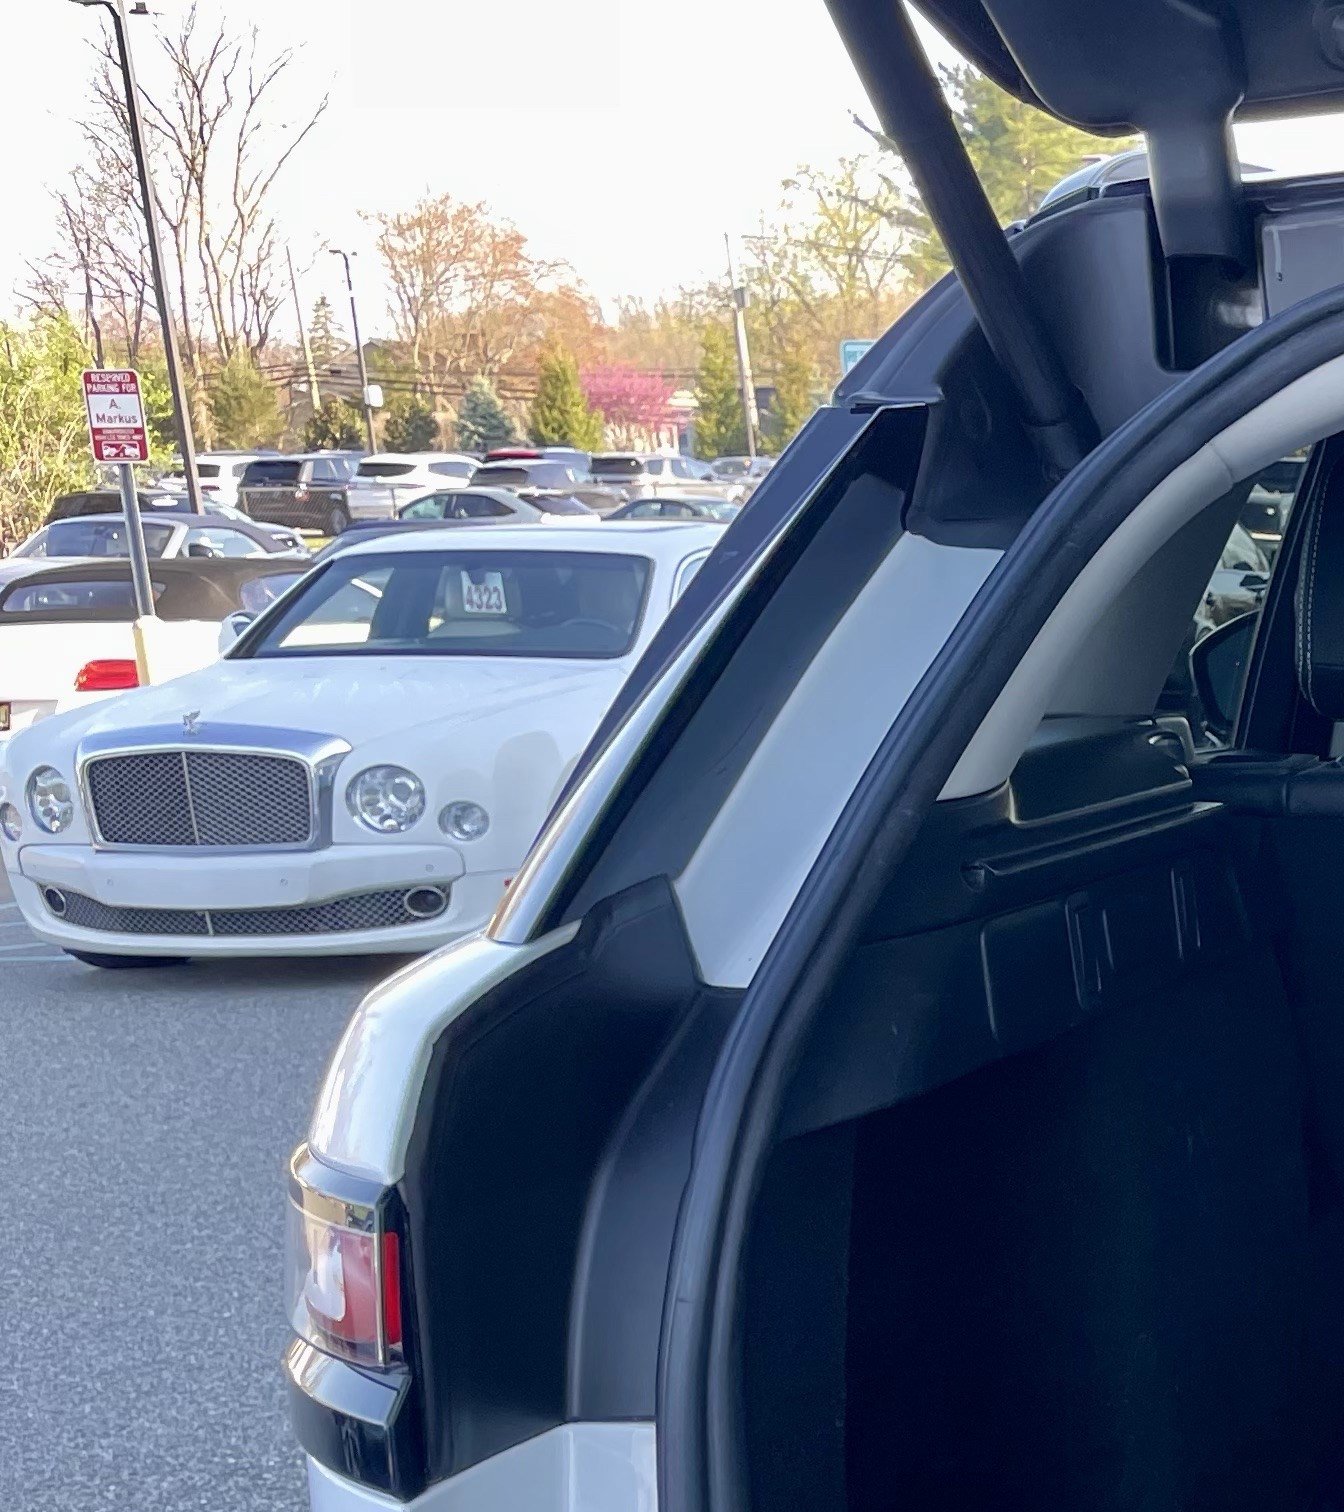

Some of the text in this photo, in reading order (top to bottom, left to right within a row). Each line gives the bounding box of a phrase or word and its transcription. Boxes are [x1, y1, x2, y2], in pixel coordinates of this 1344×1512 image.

[90, 373, 131, 382] RESERVED
[86, 383, 137, 393] PARKING FOR
[95, 413, 138, 424] Markus
[466, 585, 503, 609] 4323
